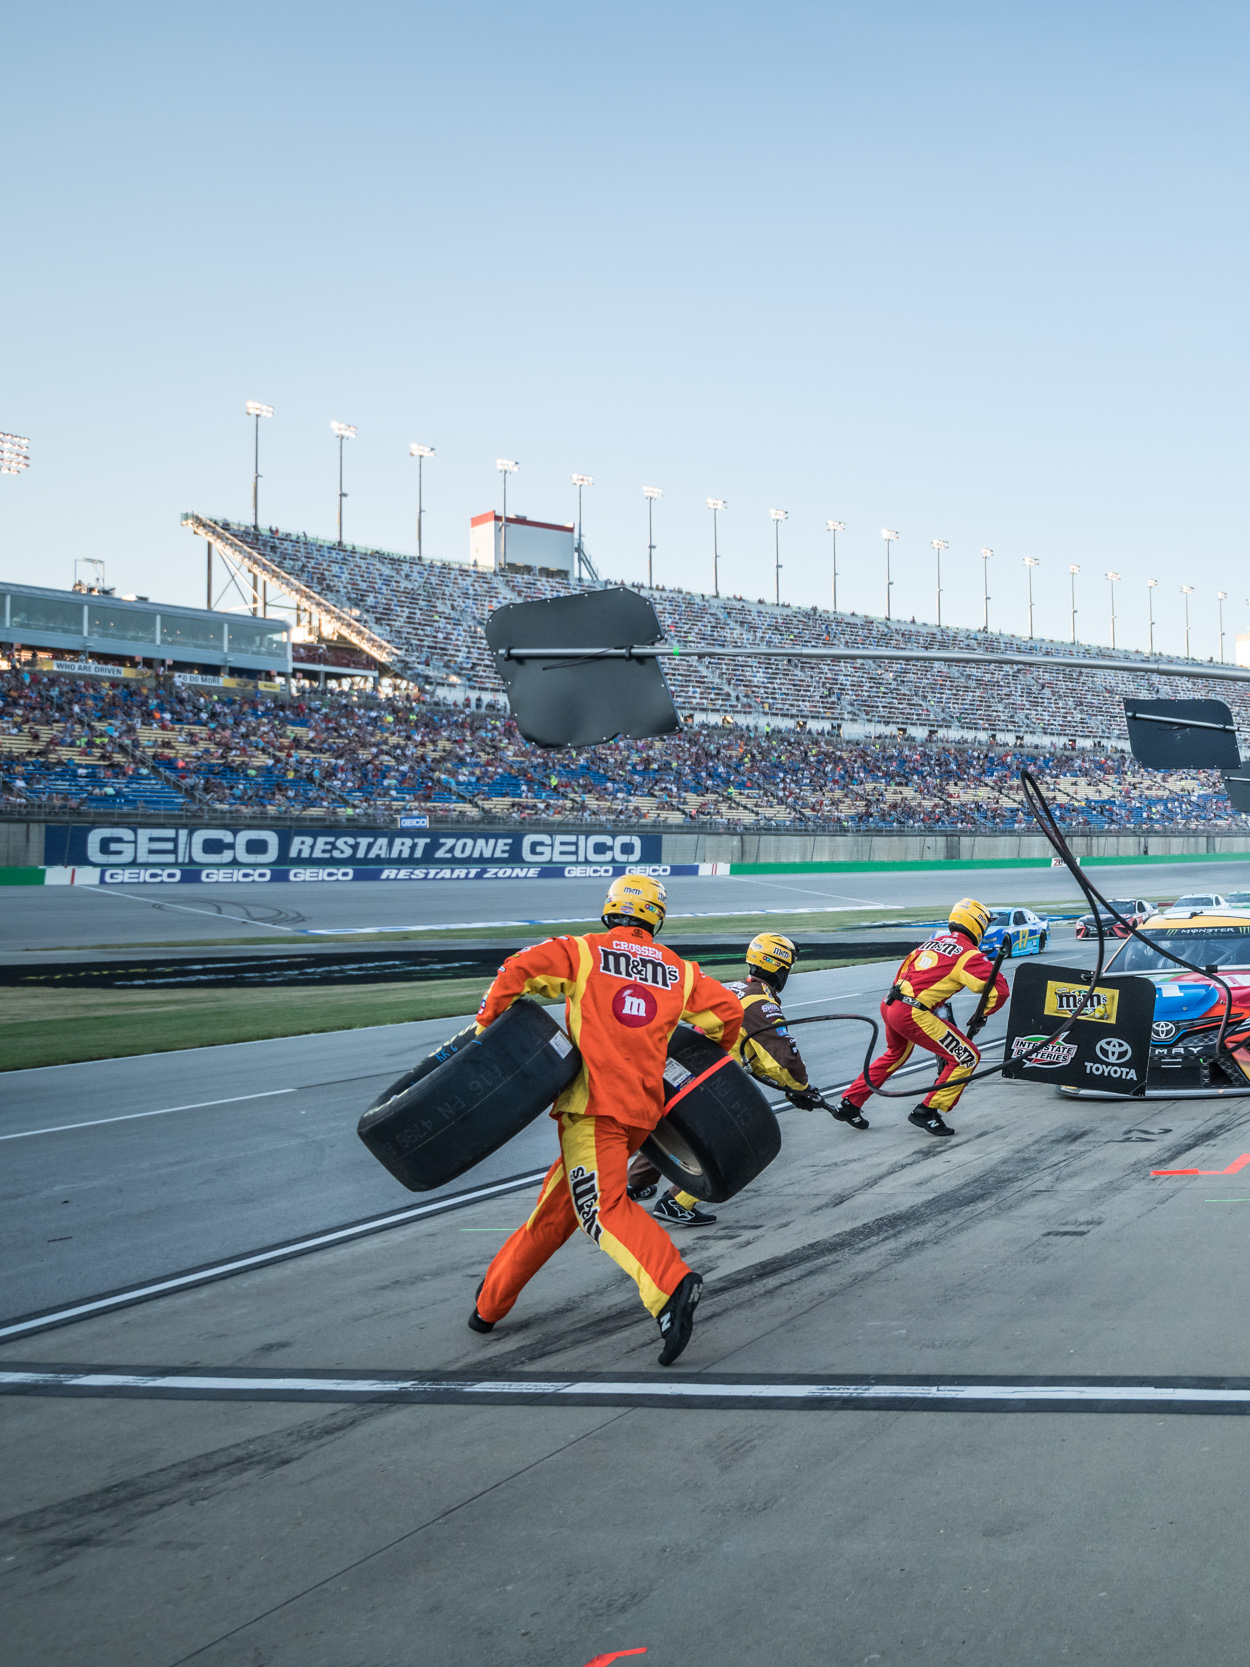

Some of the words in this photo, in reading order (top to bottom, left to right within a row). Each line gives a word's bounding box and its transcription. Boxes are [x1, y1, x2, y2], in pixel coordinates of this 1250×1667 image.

[56, 662, 76, 671] WHO
[78, 664, 92, 672] ARE
[94, 666, 122, 675] DRIVEN
[189, 674, 199, 682] DO
[201, 675, 221, 684] MORE
[401, 818, 427, 827] GEICO
[87, 828, 279, 864] GEICO
[288, 836, 430, 859] RESTART
[434, 837, 513, 858] ZONE
[522, 834, 641, 862] GEICO
[104, 868, 181, 883] GEICO
[201, 868, 271, 882] GEICO
[289, 868, 353, 882] GEICO
[380, 868, 481, 880] RESTART
[483, 867, 541, 878] ZONE
[565, 866, 613, 877] GEICO
[625, 865, 671, 876] GEICO
[1019, 929, 1029, 949] 17
[613, 941, 662, 960] CROSSEN
[1015, 1040, 1073, 1055] INTESTATE
[1017, 1050, 1068, 1062] BTERIES
[1084, 1062, 1137, 1080] TOYOTA
